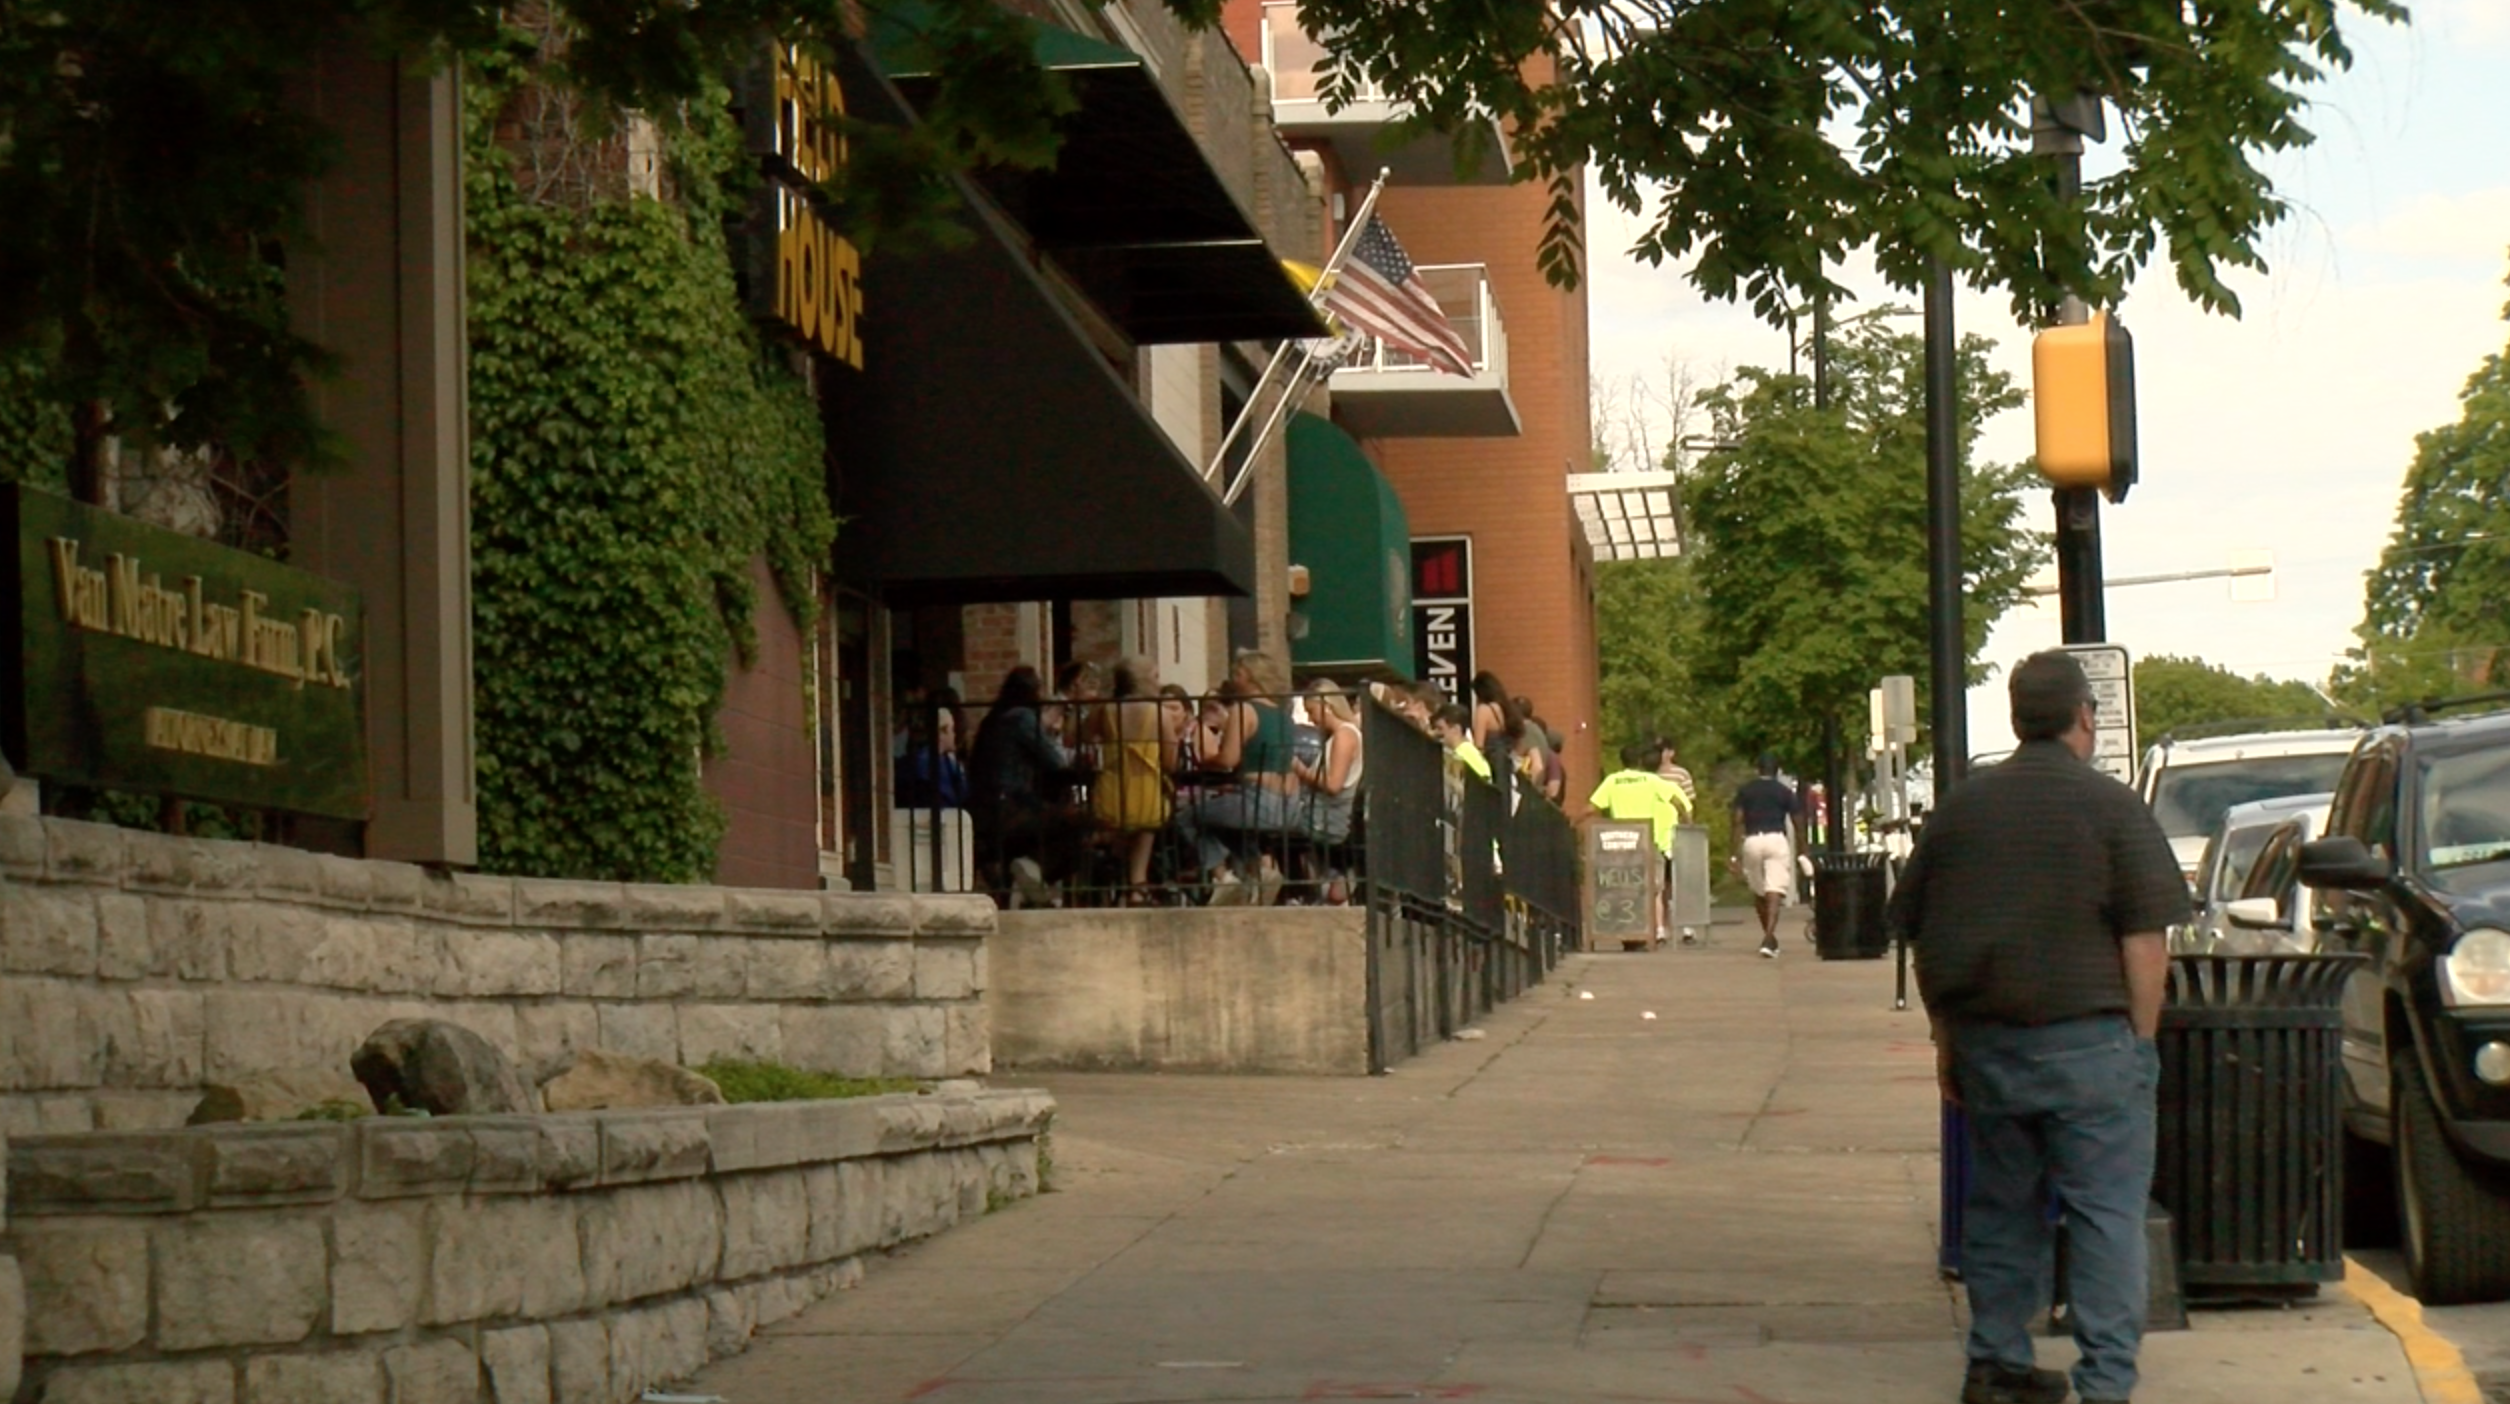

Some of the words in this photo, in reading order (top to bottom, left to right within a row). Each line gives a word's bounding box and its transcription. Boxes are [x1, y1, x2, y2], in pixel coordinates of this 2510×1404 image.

[777, 185, 864, 372] HOUSE
[50, 536, 107, 632] Van
[185, 574, 240, 661] Law
[301, 606, 350, 689] P.C.
